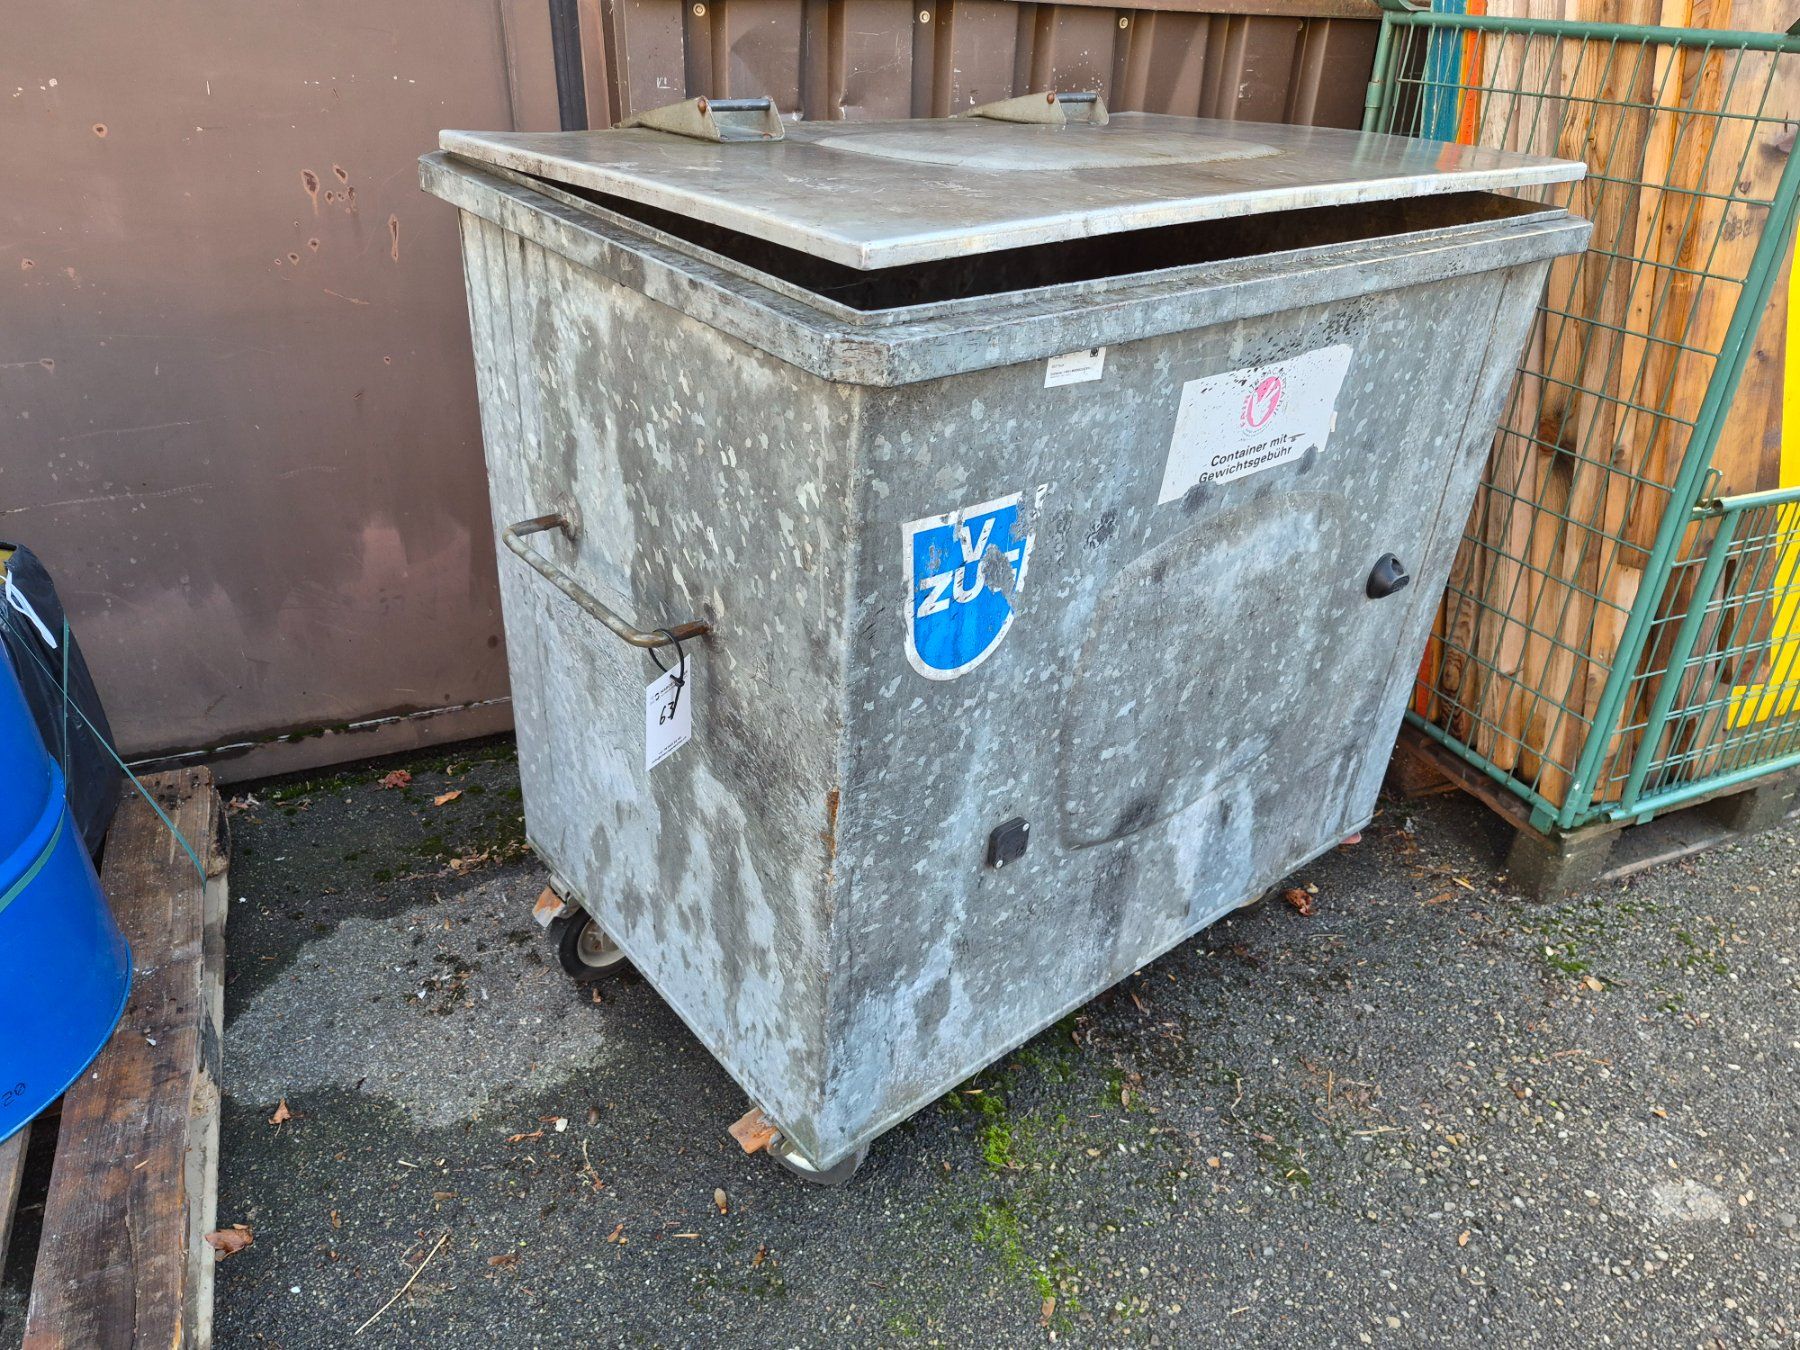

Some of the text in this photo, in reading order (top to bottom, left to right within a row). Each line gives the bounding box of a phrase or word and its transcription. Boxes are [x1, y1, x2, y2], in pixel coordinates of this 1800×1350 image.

[1199, 446, 1293, 483] Gewichtsgebühr
[1211, 434, 1288, 467] Container mit
[960, 517, 996, 563] V
